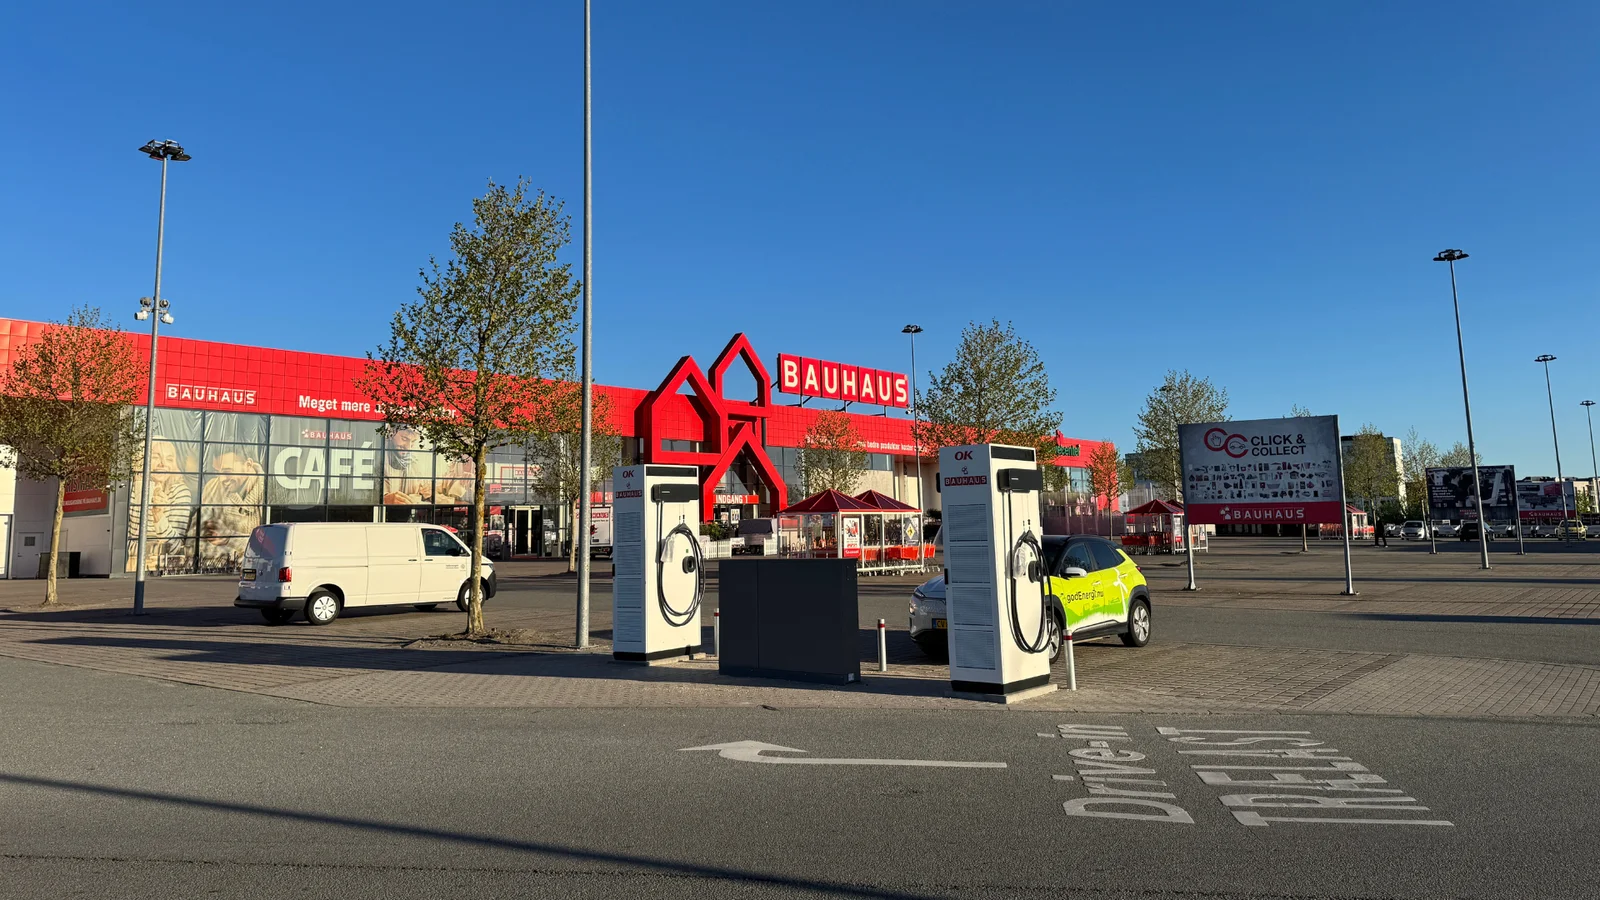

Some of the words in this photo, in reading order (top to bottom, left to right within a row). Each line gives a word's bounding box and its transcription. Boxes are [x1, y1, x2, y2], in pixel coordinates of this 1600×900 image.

[782, 359, 907, 402] BAUHAUS
[167, 385, 256, 405] BAUHAUS
[298, 395, 338, 412] Meget
[341, 399, 370, 413] mere
[310, 430, 353, 440] BAUHAUS
[1251, 434, 1292, 446] CLICK
[1296, 434, 1306, 444] &
[954, 450, 973, 461] OK
[1251, 445, 1307, 457] COLLECT
[274, 443, 375, 491] CAFÉ
[622, 469, 635, 479] OK
[945, 476, 987, 486] BAUHAUS
[616, 490, 642, 499] BAUHAUS
[715, 494, 743, 504] INDGANG
[744, 494, 748, 503] 1
[1233, 507, 1304, 519] BAUHAUS
[1036, 723, 1195, 824] Drive-in
[1155, 726, 1455, 827] TRÆLAST
